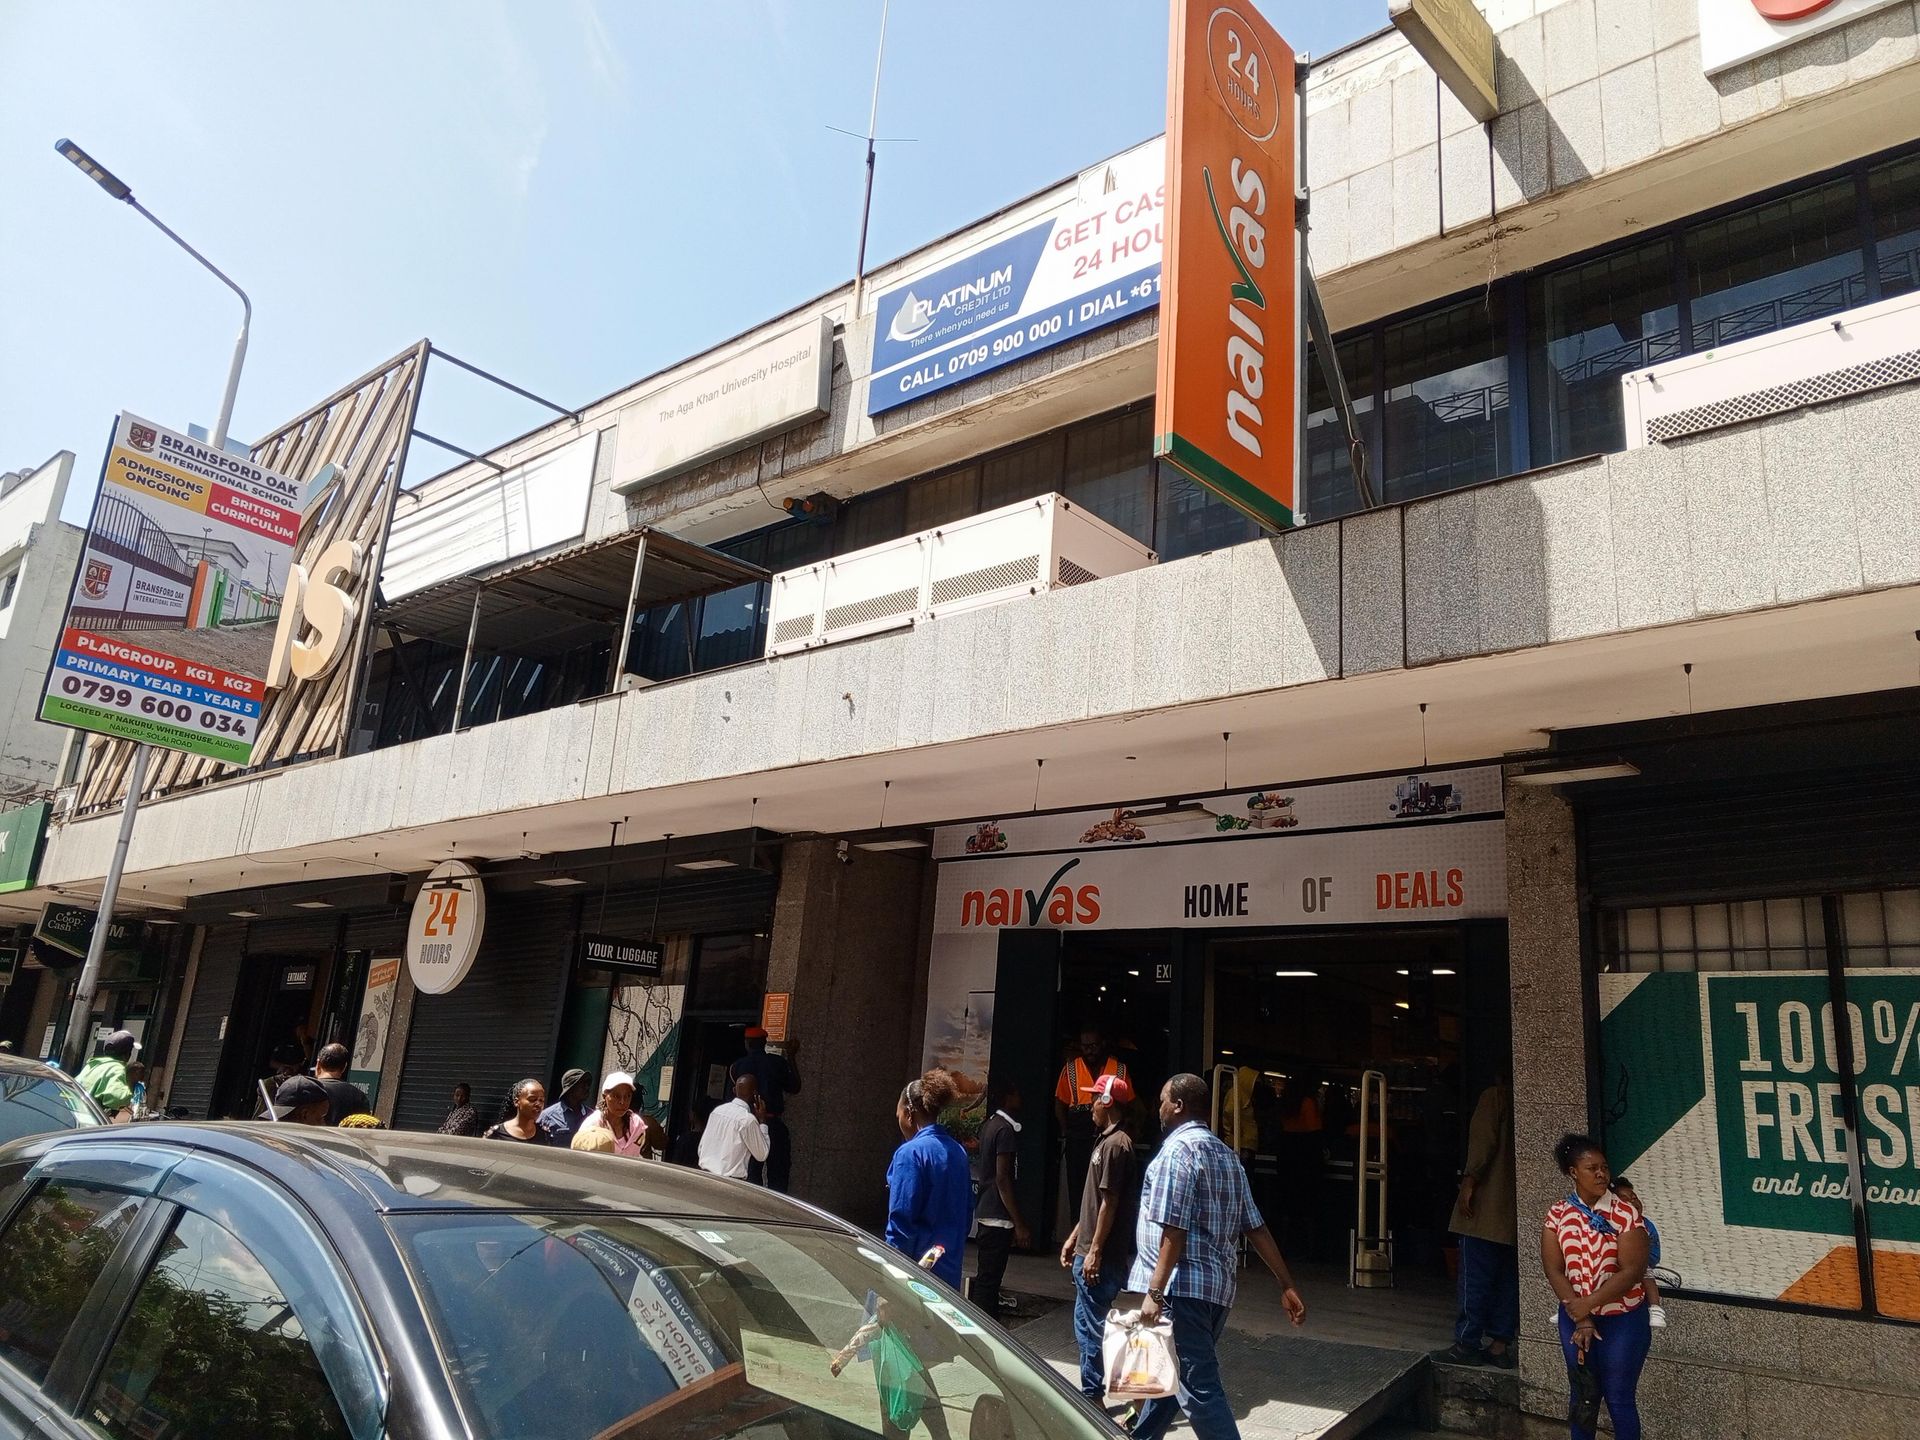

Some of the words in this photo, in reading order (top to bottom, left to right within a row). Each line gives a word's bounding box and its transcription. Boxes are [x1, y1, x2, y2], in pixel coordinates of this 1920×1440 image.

[1227, 29, 1260, 96] 24
[1227, 76, 1261, 121] HOURS
[1054, 210, 1107, 252] GET
[1072, 248, 1102, 280] 24
[912, 264, 1013, 323] PLATINUM
[954, 294, 989, 317] CREDIT
[992, 284, 1011, 300] LTD
[1202, 156, 1266, 459] naivas
[899, 363, 944, 392] CALL
[948, 345, 989, 374] 0709
[992, 330, 1024, 356] 900
[1029, 314, 1061, 342] 000
[1080, 290, 1128, 321] DIAL
[910, 333, 933, 348] There
[975, 306, 996, 322] need
[998, 301, 1010, 312] us
[658, 410, 676, 424] The
[676, 402, 694, 415] Aga
[696, 390, 720, 406] Khan
[721, 367, 768, 395] University
[770, 345, 812, 375] Hospital
[116, 456, 204, 494] ADMISSIONS
[125, 472, 190, 501] ONGOING
[158, 451, 249, 492] INTERNATIONAL
[252, 487, 294, 509] SCHOOL
[161, 434, 262, 482] BRANSFORD
[265, 476, 298, 497] OAK
[210, 503, 295, 540] CURRICULUM
[230, 495, 281, 521] BRITISH
[136, 580, 174, 596] BRANSFORD
[175, 591, 185, 600] OAK
[66, 656, 140, 683] PRIMARY
[143, 675, 182, 695] YEAR
[186, 687, 192, 698] 1
[204, 692, 241, 711] YEAR
[244, 703, 253, 713] 5
[77, 635, 178, 674] PLAYGROUP,
[185, 666, 216, 685] KG1,
[223, 676, 253, 694] KG2
[60, 702, 102, 717] LOCATED
[102, 713, 115, 721] AT
[116, 715, 154, 731] NAKURU,
[156, 726, 214, 745] WHITEHOUSE,
[214, 739, 240, 751] ALONG
[62, 675, 132, 708] 0799
[140, 696, 192, 723] 600
[200, 711, 246, 737] 034
[146, 733, 169, 742] SOLAI
[170, 738, 192, 748] ROAD
[424, 891, 459, 937] 24
[960, 858, 1101, 928] naivas
[1184, 882, 1249, 918] HOME
[1302, 876, 1333, 913] OF
[1376, 868, 1464, 911] DEALS
[47, 920, 72, 932] Cash
[419, 943, 452, 965] HOURS
[588, 942, 614, 959] YOUR
[616, 946, 658, 965] LUGGAGE
[286, 971, 308, 982] ENTRANCE
[1735, 1000, 1920, 1076] 100%
[1752, 1172, 1803, 1196] and
[1810, 1174, 1920, 1206] delciou
